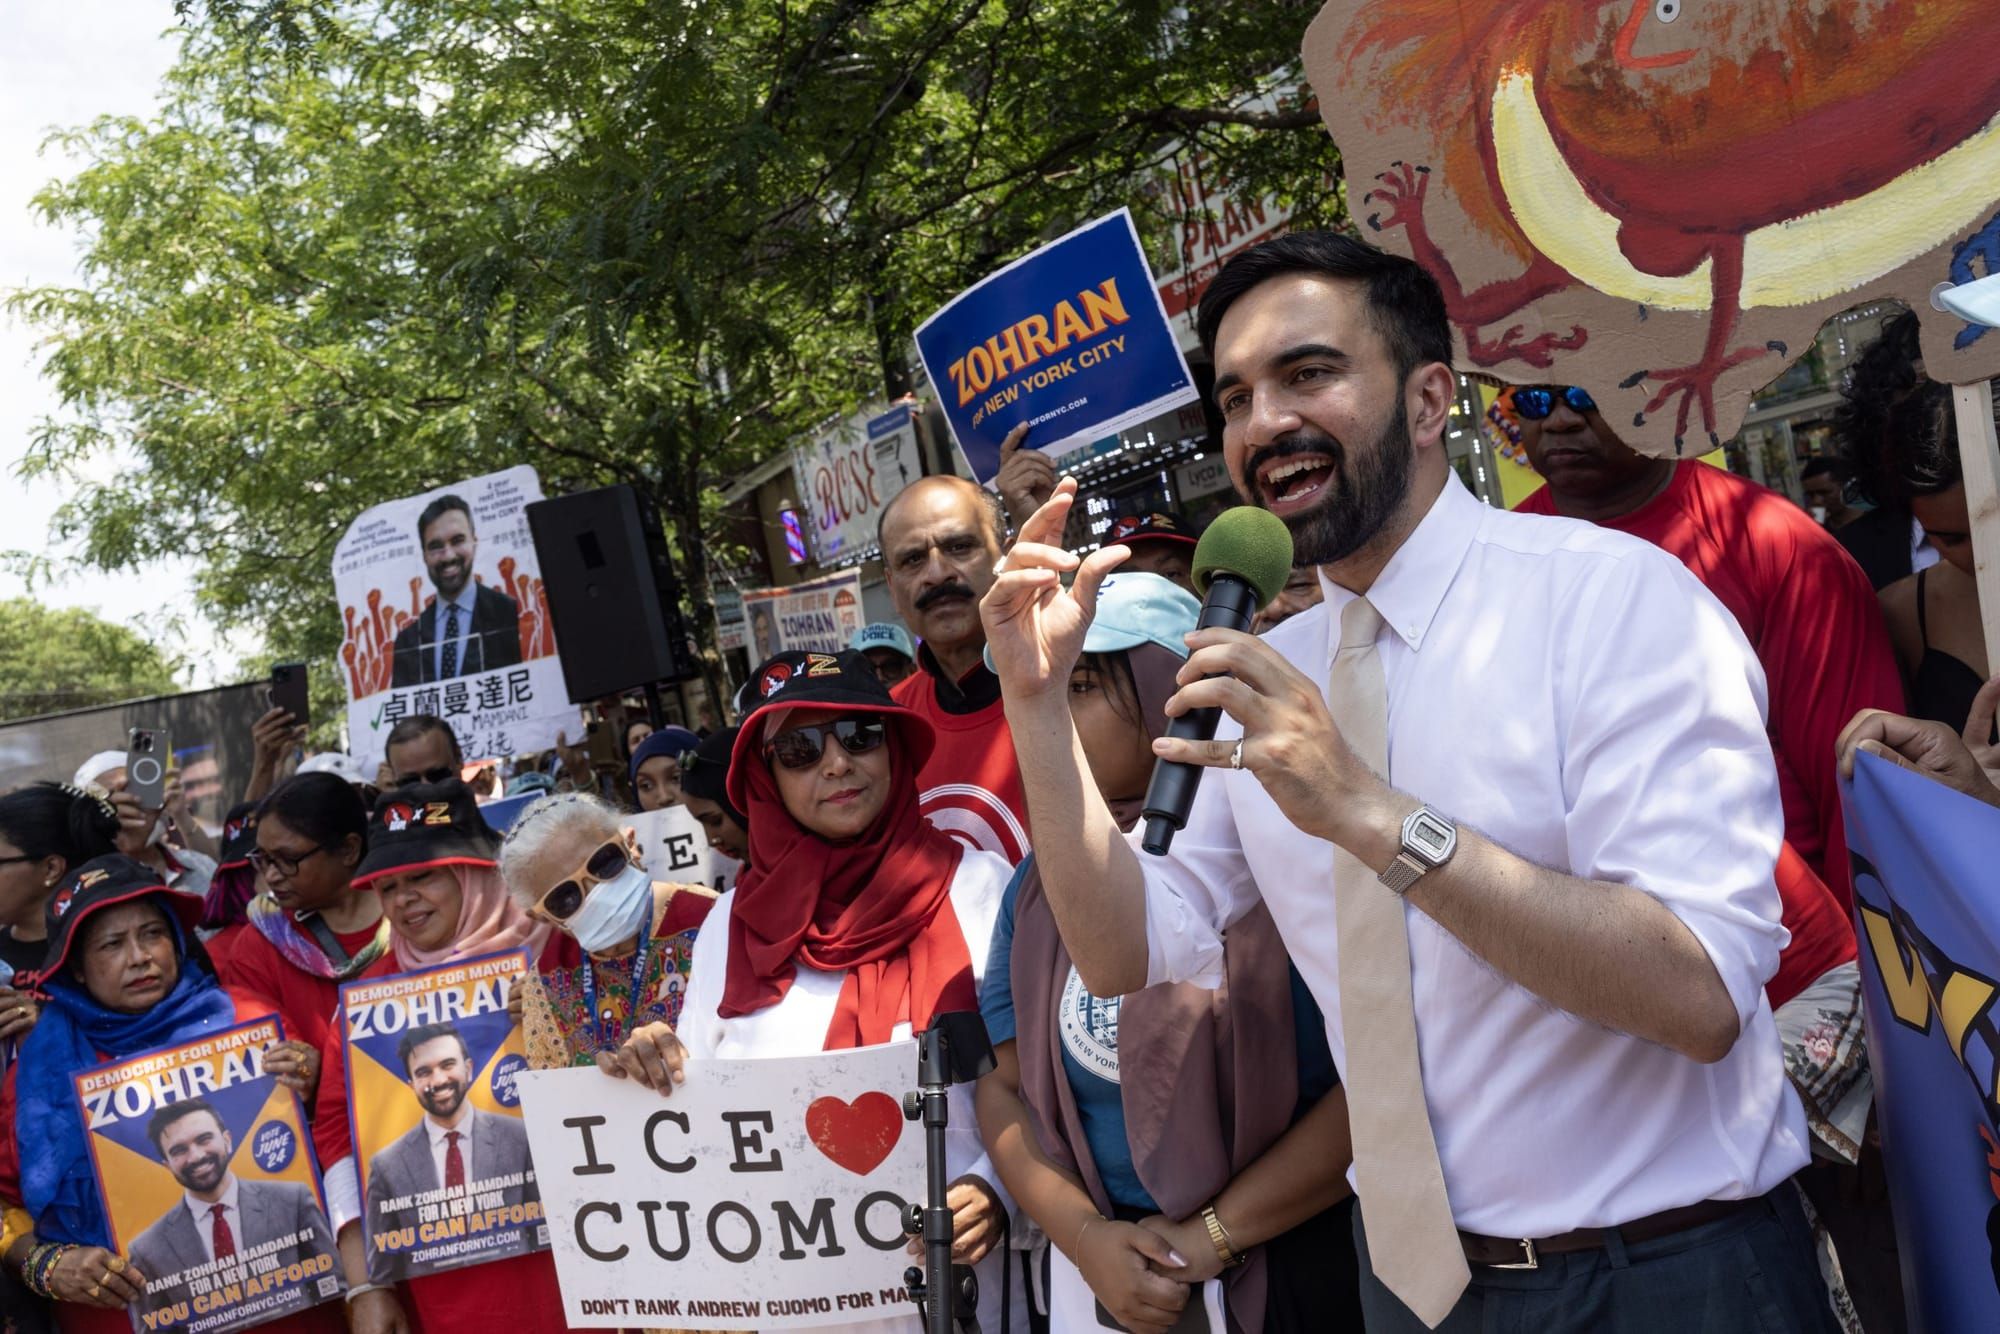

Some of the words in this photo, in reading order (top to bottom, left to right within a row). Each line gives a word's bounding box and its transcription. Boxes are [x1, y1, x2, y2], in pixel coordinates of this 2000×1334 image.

[948, 277, 1130, 408] ZOHRAN
[971, 407, 984, 429] FOR
[984, 384, 1019, 416] NEW
[1021, 358, 1077, 394] YORK
[1079, 335, 1125, 369] CITY
[781, 612, 835, 638] ZOHRAN
[472, 706, 529, 731] MAMDANI
[350, 978, 433, 1004] DEMOCRAT
[436, 970, 466, 985] FOR
[468, 957, 522, 980] MAYOR
[583, 962, 593, 994] FUZE
[634, 948, 648, 980] FUZE
[84, 1055, 177, 1092] DEMOCRAT
[179, 1045, 213, 1061] FOR
[215, 1025, 273, 1053] MAYOR
[1072, 1033, 1094, 1057] NEW
[255, 1131, 290, 1158] JUNE
[261, 1126, 281, 1141] VOTE
[266, 1148, 286, 1168] 24
[380, 1196, 414, 1214] RANK
[415, 1184, 464, 1207] ZOHRAN
[466, 1172, 524, 1195] MAMDANI
[418, 1205, 439, 1223] FOR
[440, 1204, 449, 1218] A
[450, 1196, 474, 1216] NEW
[476, 1190, 505, 1210] YORK
[373, 1227, 415, 1253] YOU
[419, 1216, 465, 1243] CAN
[574, 1190, 906, 1263] CUOMO
[146, 1273, 182, 1295] RANK
[184, 1254, 235, 1282] ZOHRAN
[237, 1233, 298, 1261] MAMDANI
[299, 1227, 314, 1243] #1
[411, 1230, 521, 1264] ZOHRANFORNYC.COM
[143, 1301, 189, 1330] YOU
[193, 1284, 242, 1314] CAN
[247, 1253, 334, 1298] AFFORD
[189, 1278, 212, 1297] FOR
[213, 1275, 223, 1288] A
[224, 1265, 248, 1285] NEW
[250, 1254, 280, 1276] YORK
[187, 1287, 301, 1334] ZOHRANFORNYC.COM
[581, 1299, 630, 1315] DON'T
[635, 1299, 682, 1316] RANK
[687, 1300, 761, 1317] ANDREW
[766, 1297, 831, 1316] CUOMO
[836, 1292, 874, 1311] FOR
